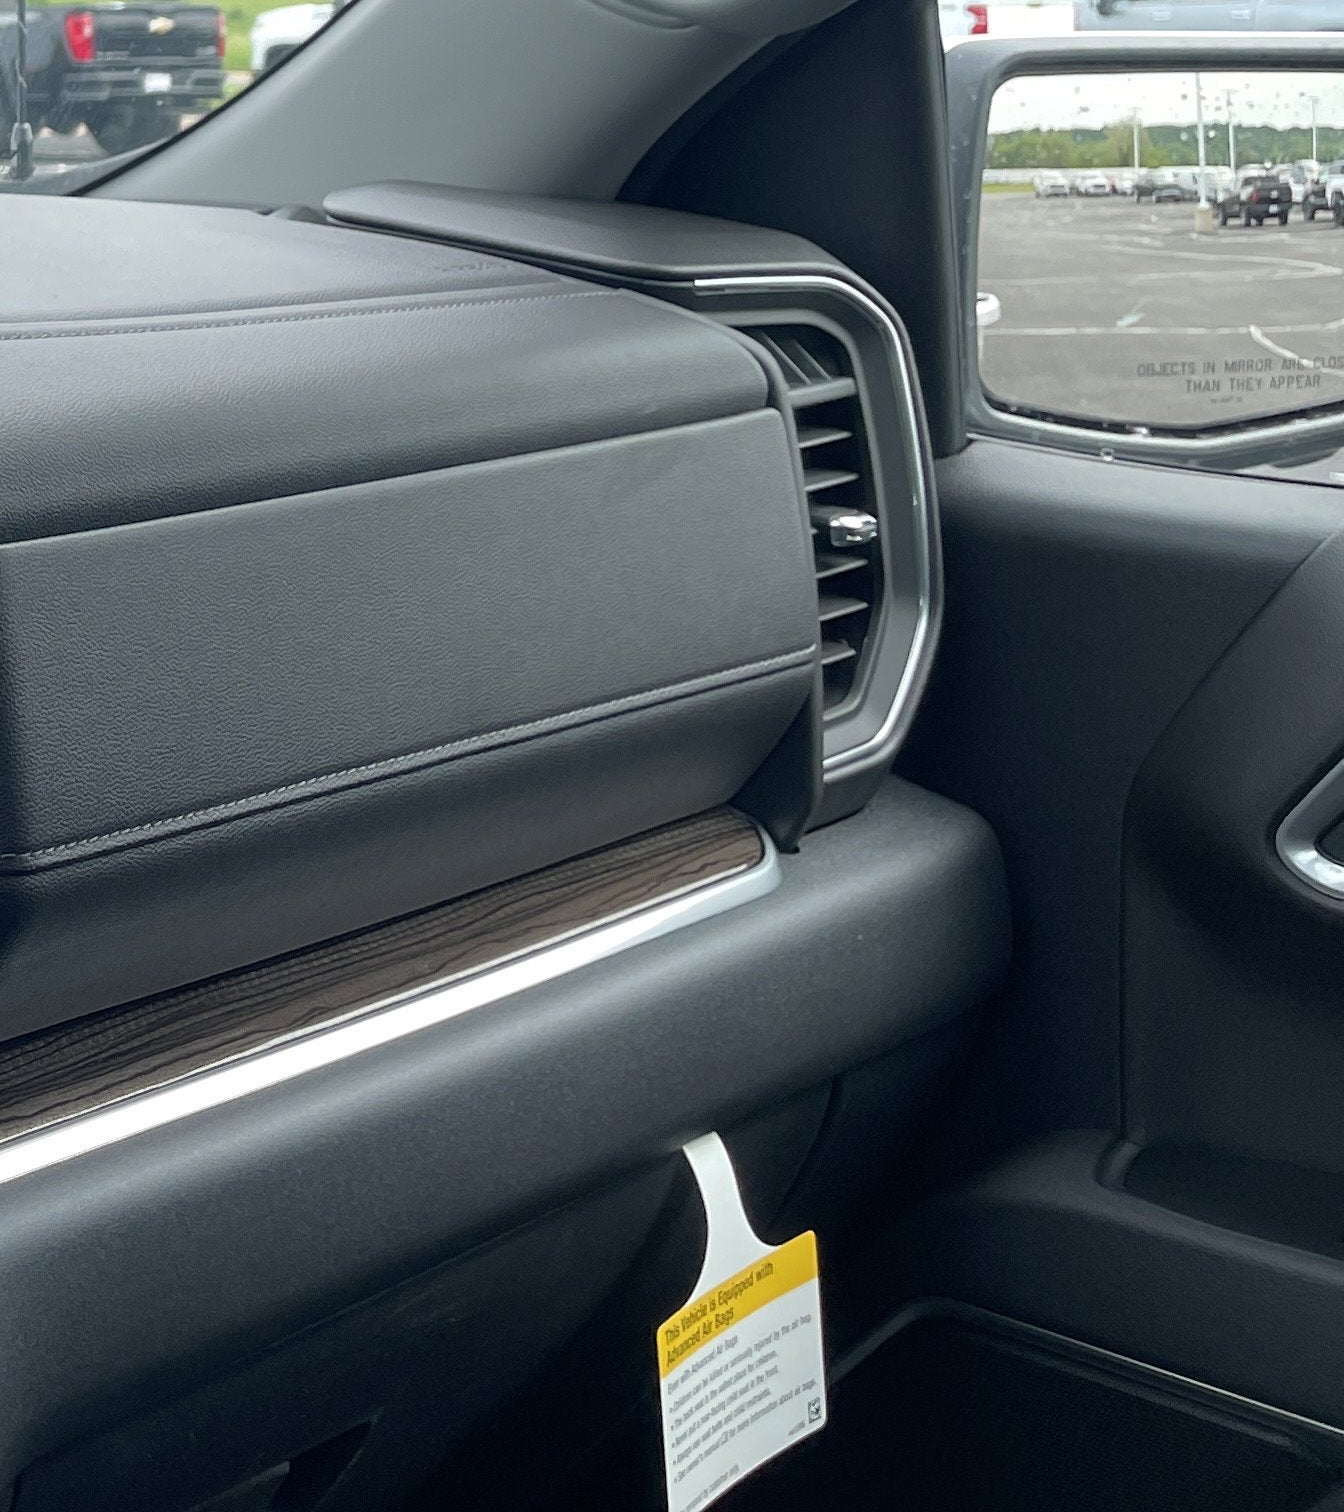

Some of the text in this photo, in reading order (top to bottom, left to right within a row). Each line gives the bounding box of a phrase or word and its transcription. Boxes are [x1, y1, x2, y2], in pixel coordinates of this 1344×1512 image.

[1136, 361, 1196, 377] OBJECTS
[1203, 360, 1216, 375] IN
[1224, 359, 1273, 374] MIRROR
[1185, 374, 1322, 393] THAN THEY APPEAR
[664, 1261, 774, 1346] This Vehicle is Equipped with
[666, 1306, 735, 1368] Advanced Air Bags
